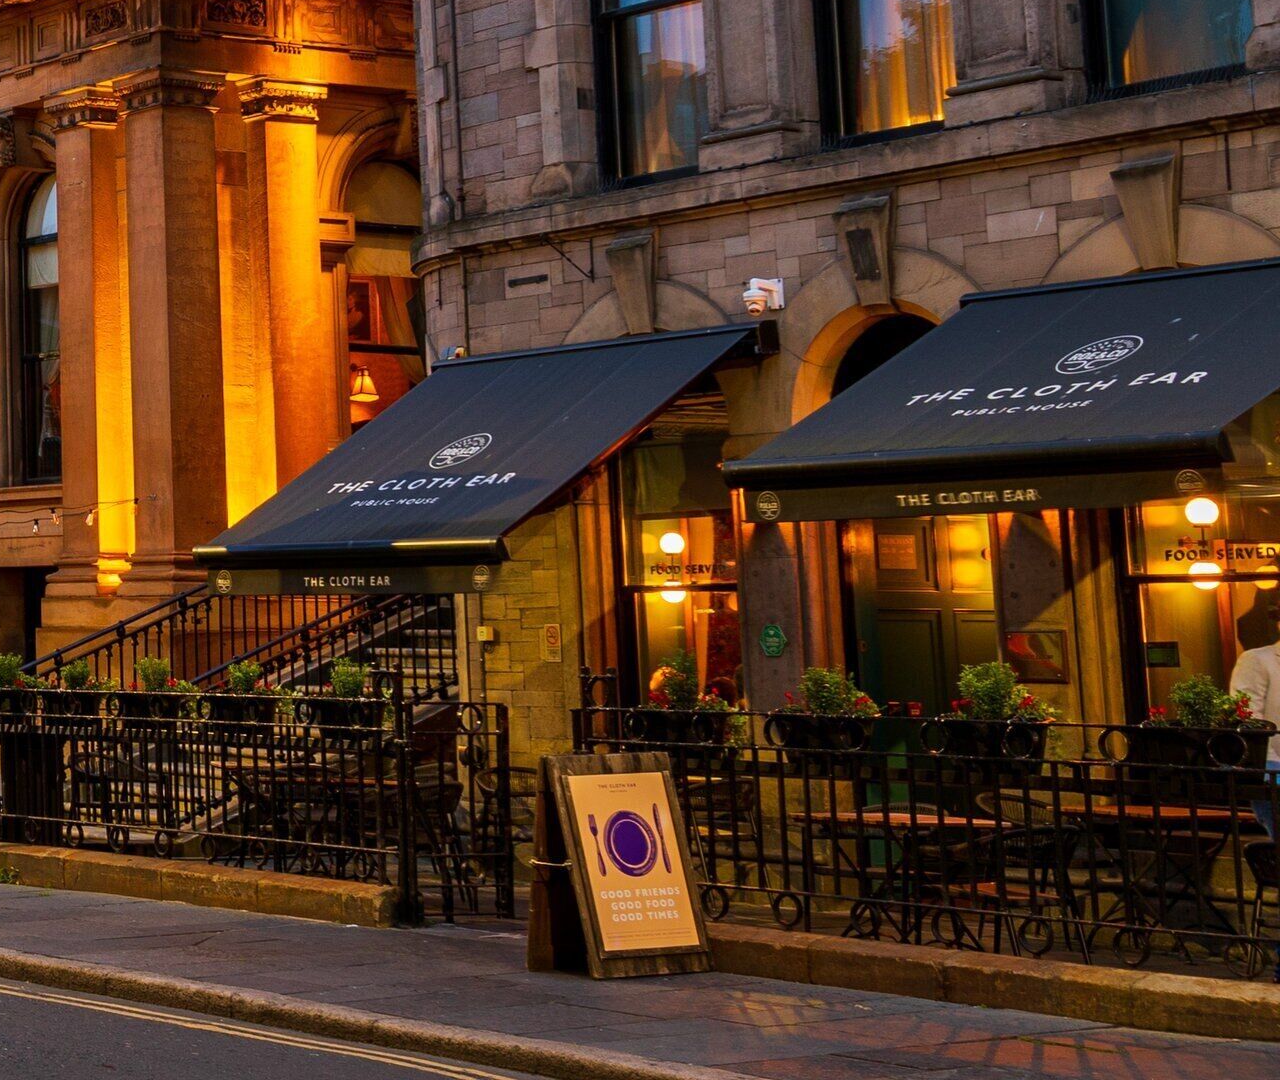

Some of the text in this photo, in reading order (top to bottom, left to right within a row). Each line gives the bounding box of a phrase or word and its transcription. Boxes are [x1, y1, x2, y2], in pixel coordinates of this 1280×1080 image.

[906, 371, 1208, 407] THE CLOTH EAR
[951, 400, 1094, 417] PUBLIC HOUSE
[327, 472, 517, 494] THE CLOTH EAR
[350, 496, 440, 507] PUBLIC HOUSE
[895, 488, 1042, 507] THE CLOTH EAR
[1164, 547, 1276, 561] FOOD SERVED
[650, 565, 681, 575] FOOD
[304, 575, 391, 587] THE CLOTH EAR
[600, 886, 680, 899] GOOD FRIENDS
[611, 898, 675, 910] GOOD FOOD
[612, 910, 679, 922] GOOD TIMES
